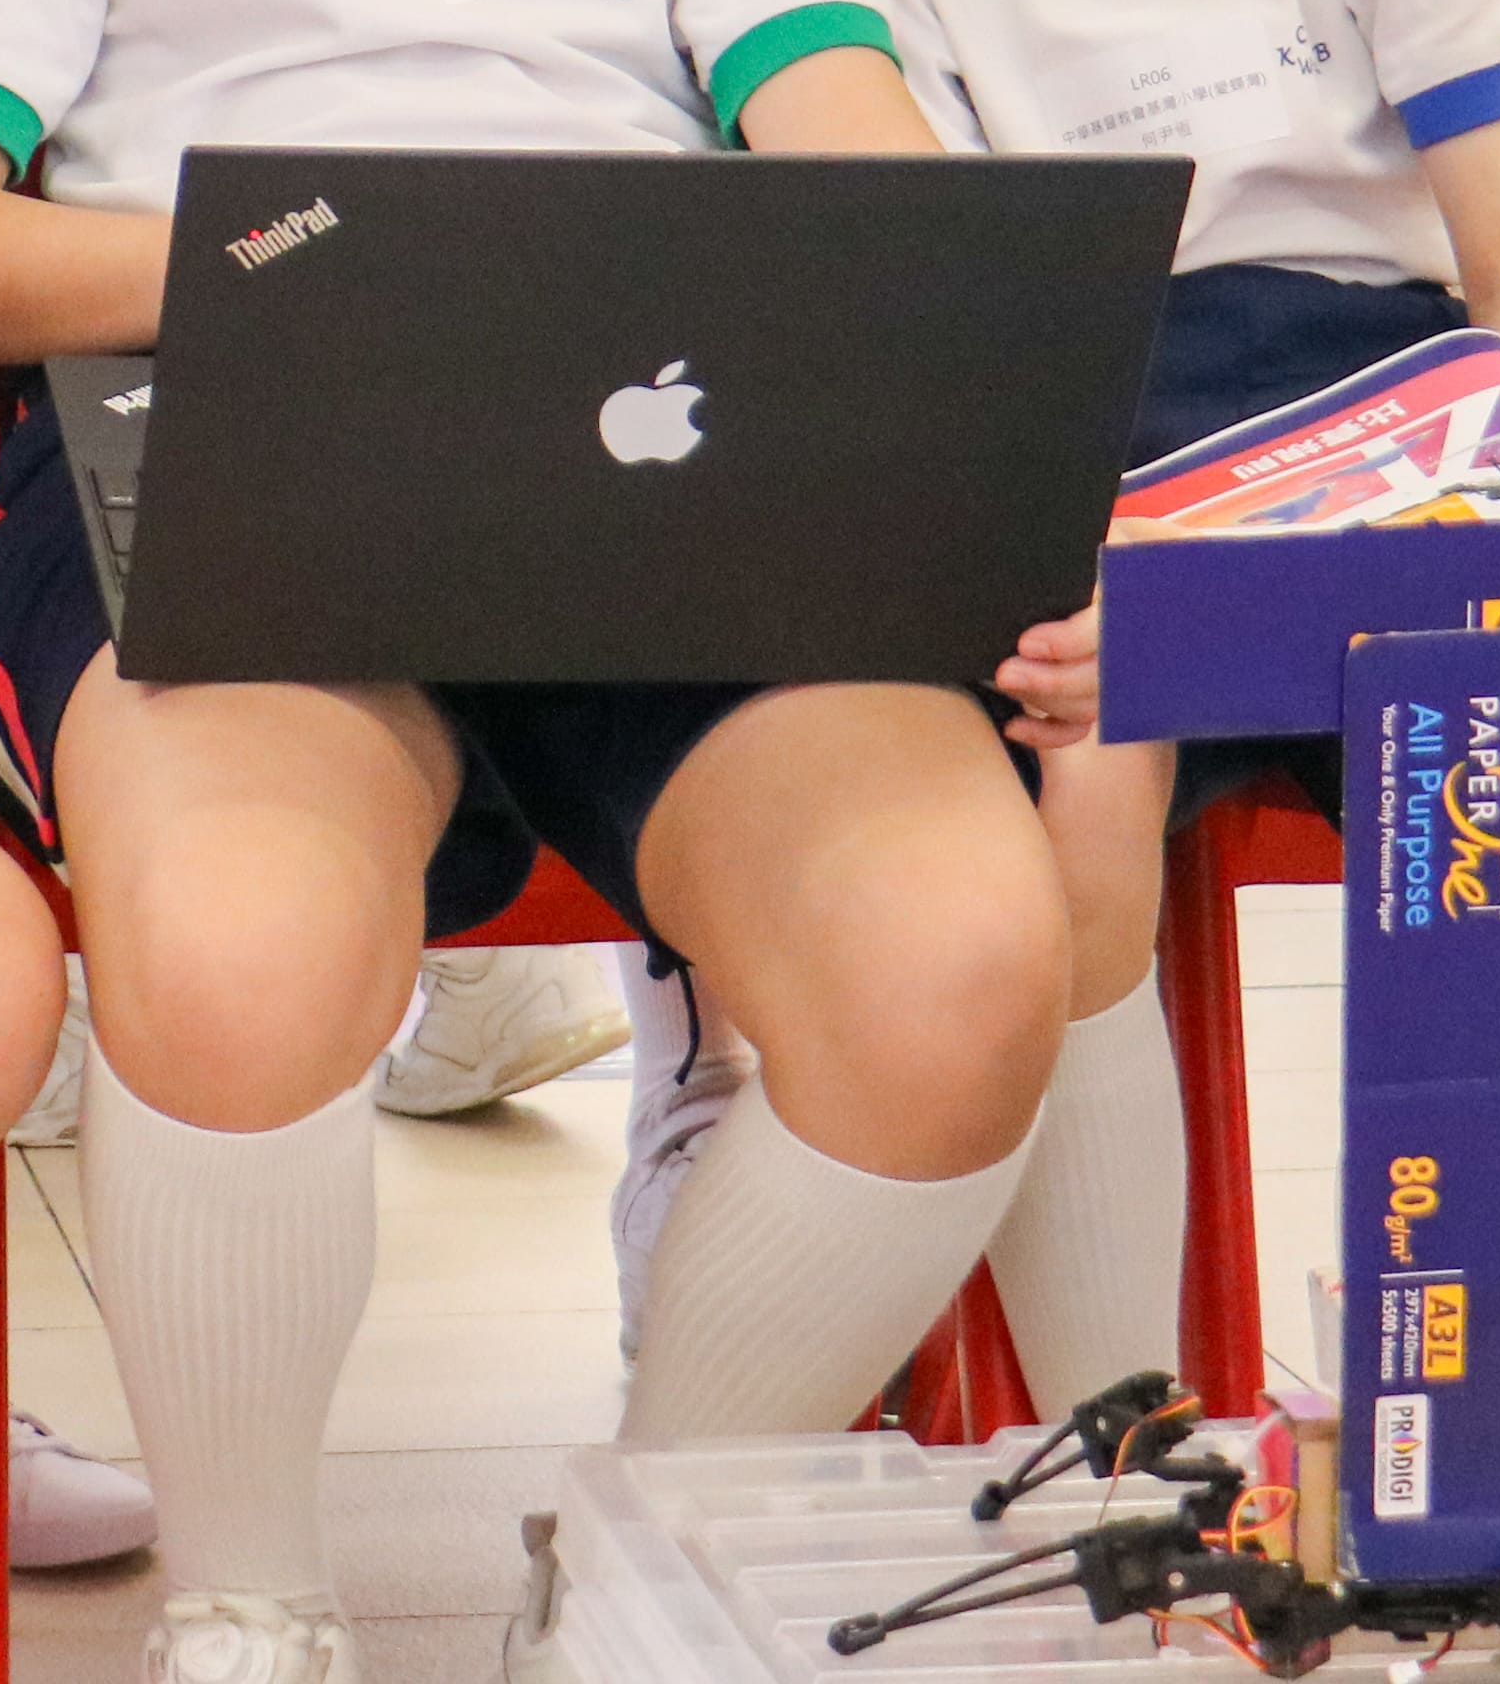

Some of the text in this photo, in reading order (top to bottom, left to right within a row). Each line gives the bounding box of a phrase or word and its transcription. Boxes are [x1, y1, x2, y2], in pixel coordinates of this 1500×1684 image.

[1130, 66, 1171, 91] LR06
[225, 197, 339, 270] ThinkPad
[1381, 703, 1397, 739] Your
[1381, 743, 1396, 773] One
[1467, 695, 1500, 824] PAPER
[1378, 790, 1396, 823] Only
[1396, 702, 1445, 927] All Purpose
[1379, 827, 1395, 889] Premium
[1376, 893, 1394, 932] Paper
[1380, 1290, 1398, 1380] 5x500 sheets
[1426, 1295, 1458, 1368] A3L
